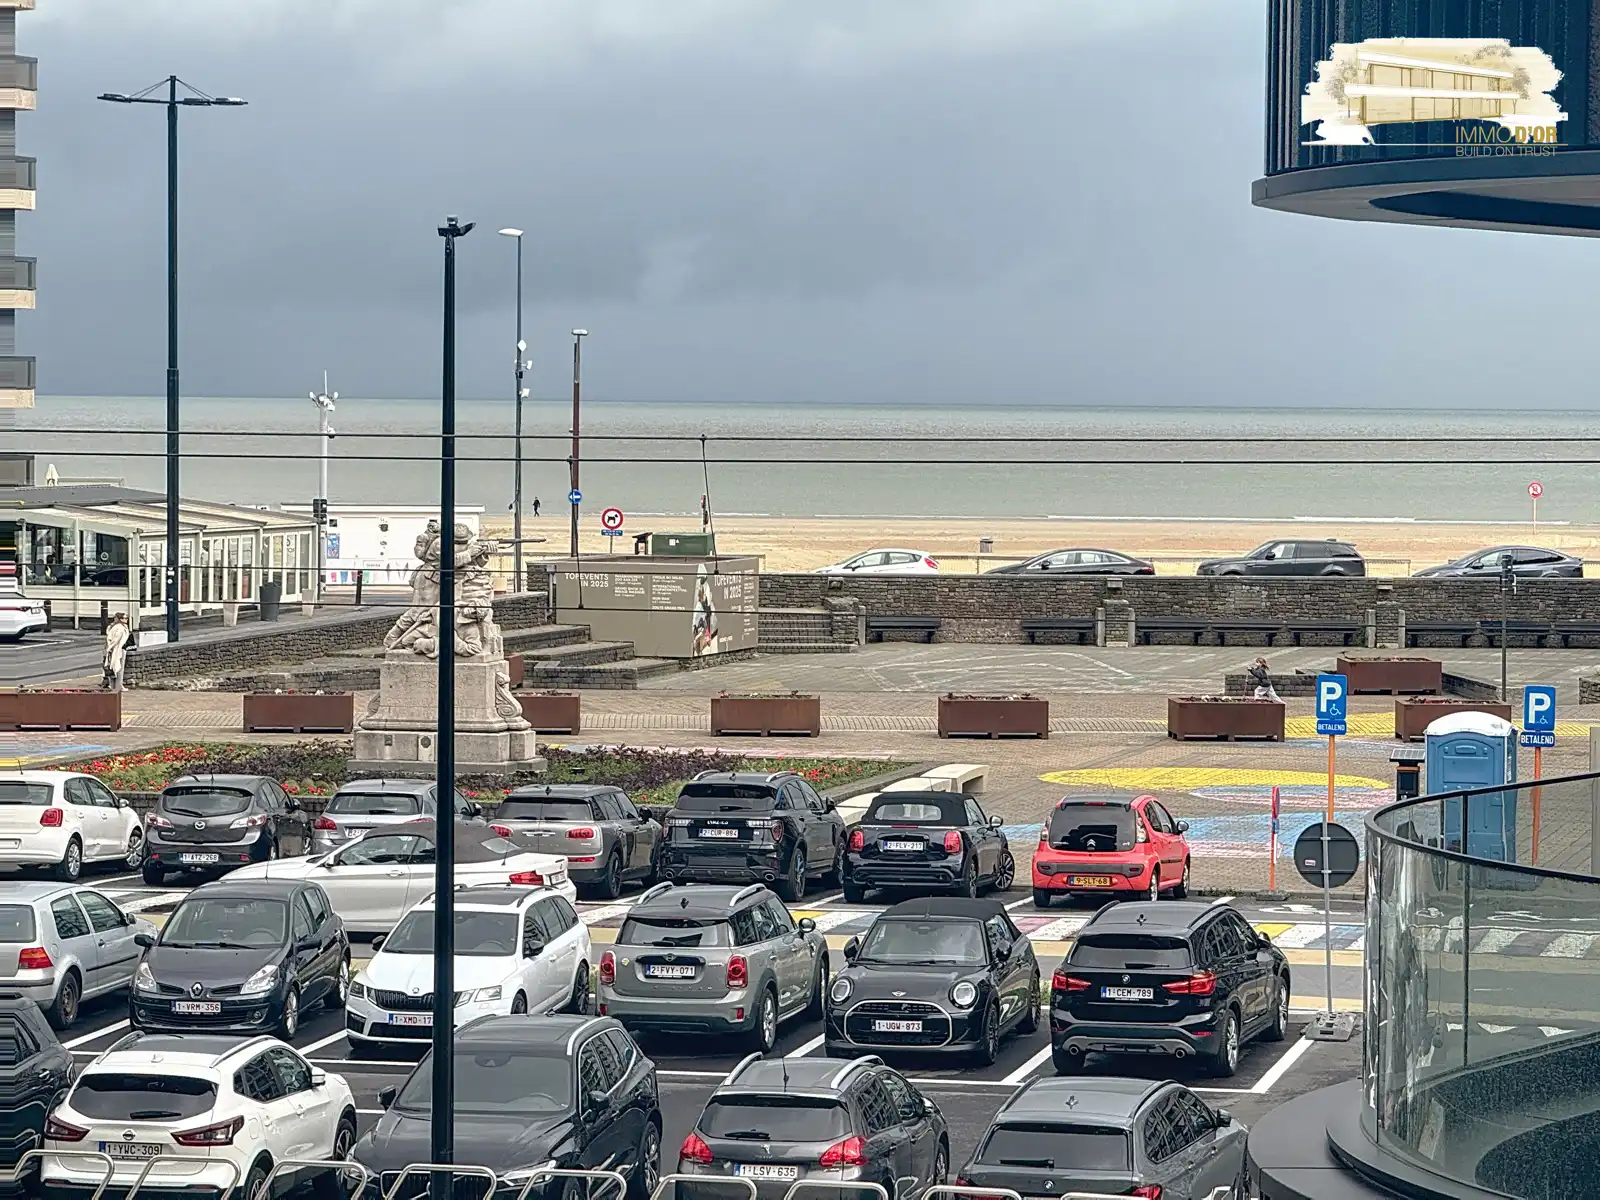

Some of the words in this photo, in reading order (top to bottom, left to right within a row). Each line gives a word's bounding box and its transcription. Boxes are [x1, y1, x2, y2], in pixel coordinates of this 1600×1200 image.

[565, 573, 609, 581] TOPEVENTS
[714, 571, 742, 587] TOPEVENTS
[724, 587, 729, 600] IN
[730, 585, 742, 599] 2025
[1321, 682, 1342, 712] P
[1529, 693, 1551, 724] P
[1318, 723, 1345, 731] BETALEND
[1521, 735, 1554, 745] BETALEND
[1076, 877, 1108, 885] 9-SLT-68
[177, 1002, 220, 1012] 1-VRM-356
[394, 1015, 433, 1025] 1-XMD-17
